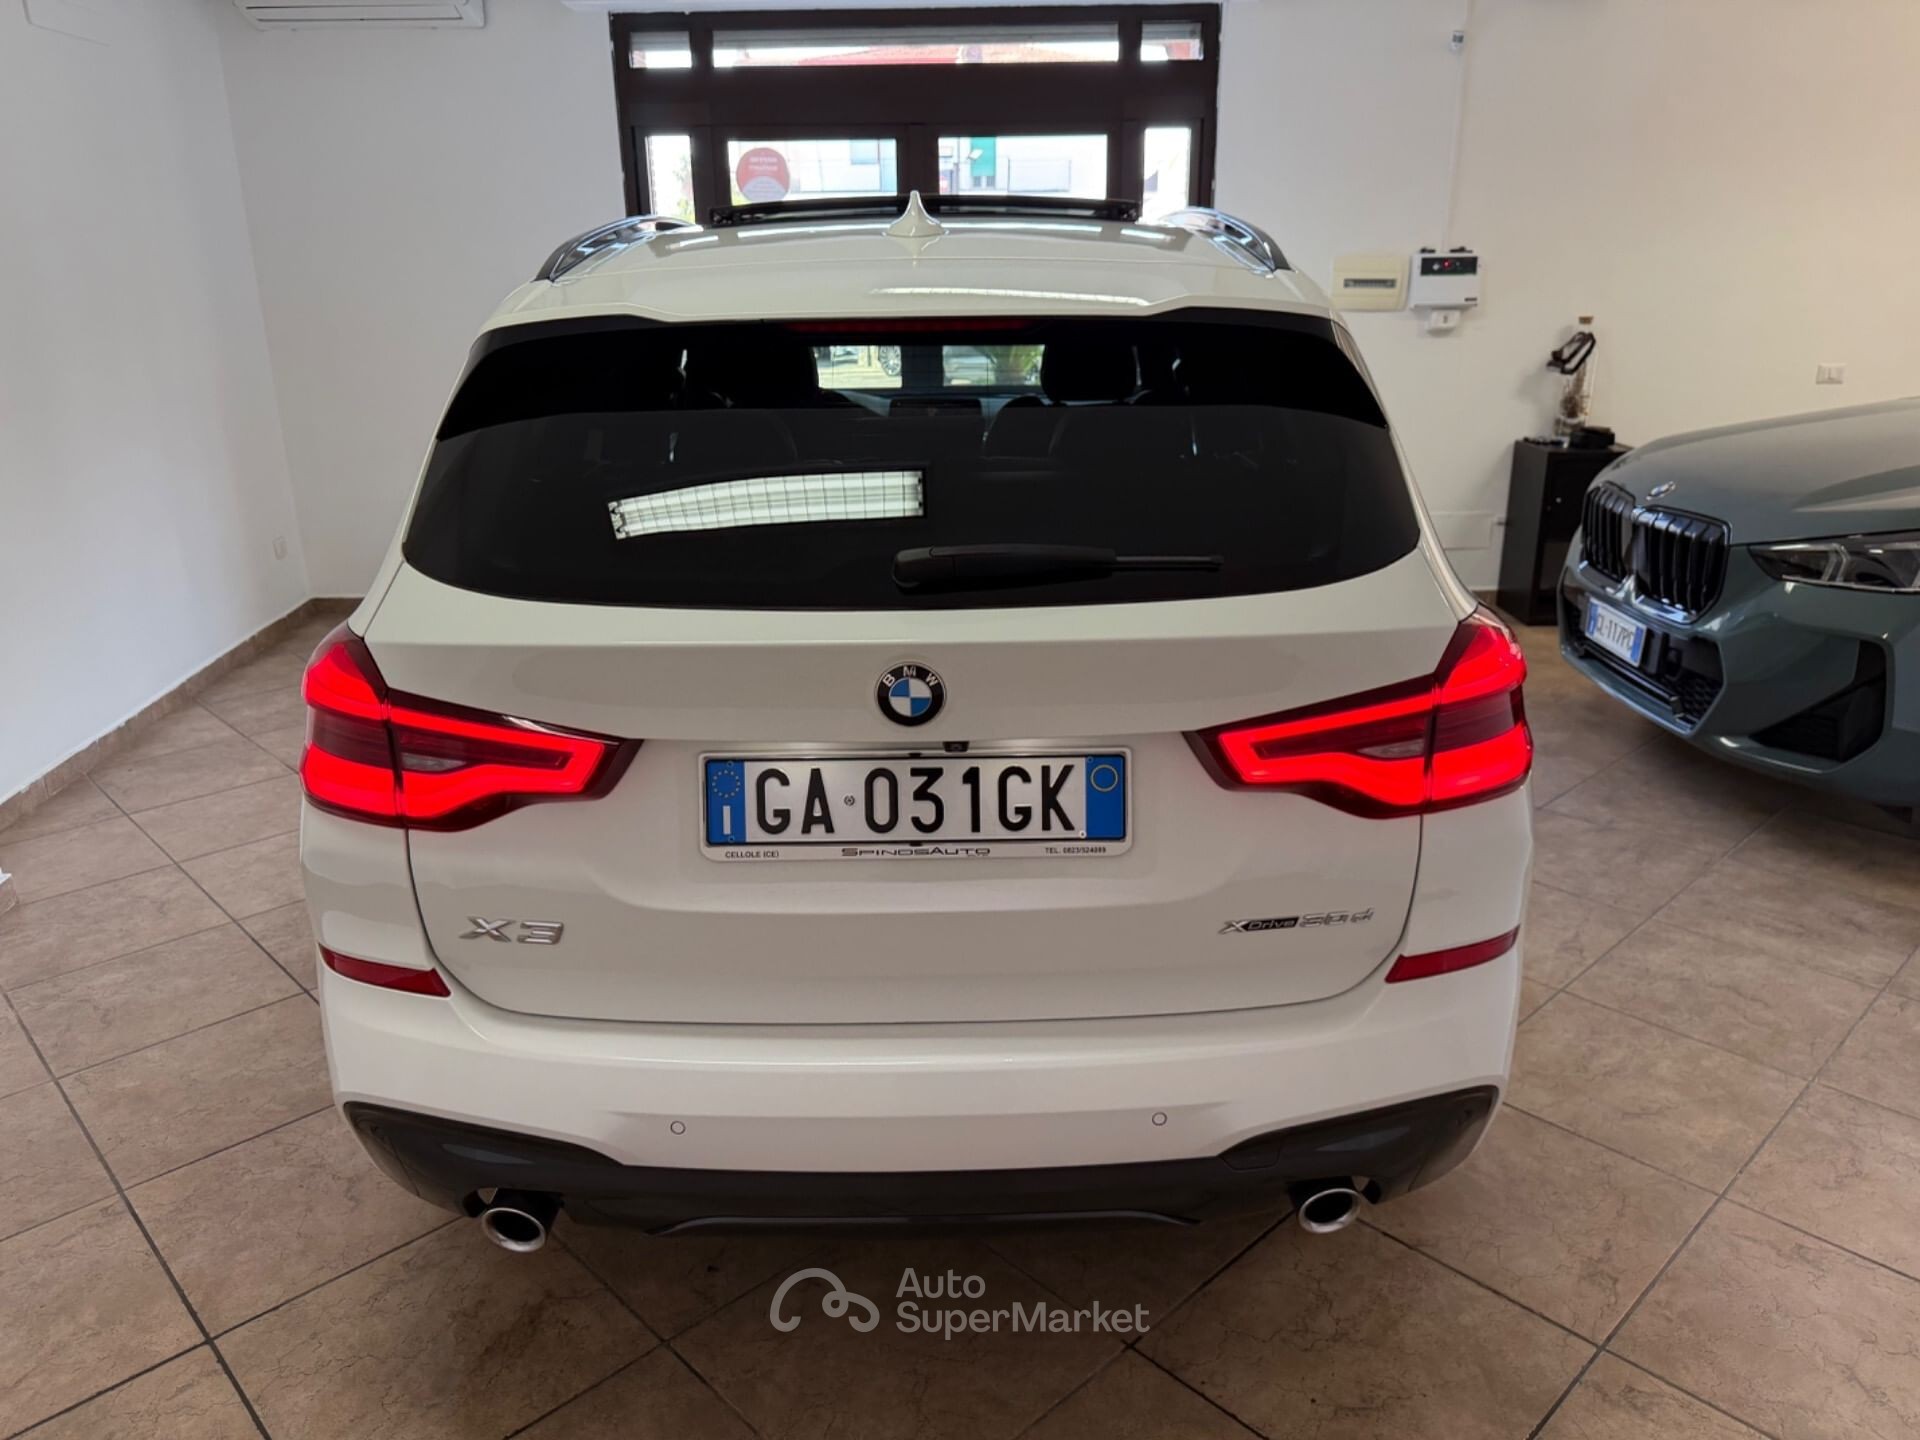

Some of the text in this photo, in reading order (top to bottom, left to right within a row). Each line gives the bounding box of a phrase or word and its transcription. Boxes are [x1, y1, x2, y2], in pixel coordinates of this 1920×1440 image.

[882, 665, 938, 687] BMW
[756, 764, 1075, 835] GA 031GK
[725, 850, 761, 859] CELLOLE
[459, 916, 564, 945] X3
